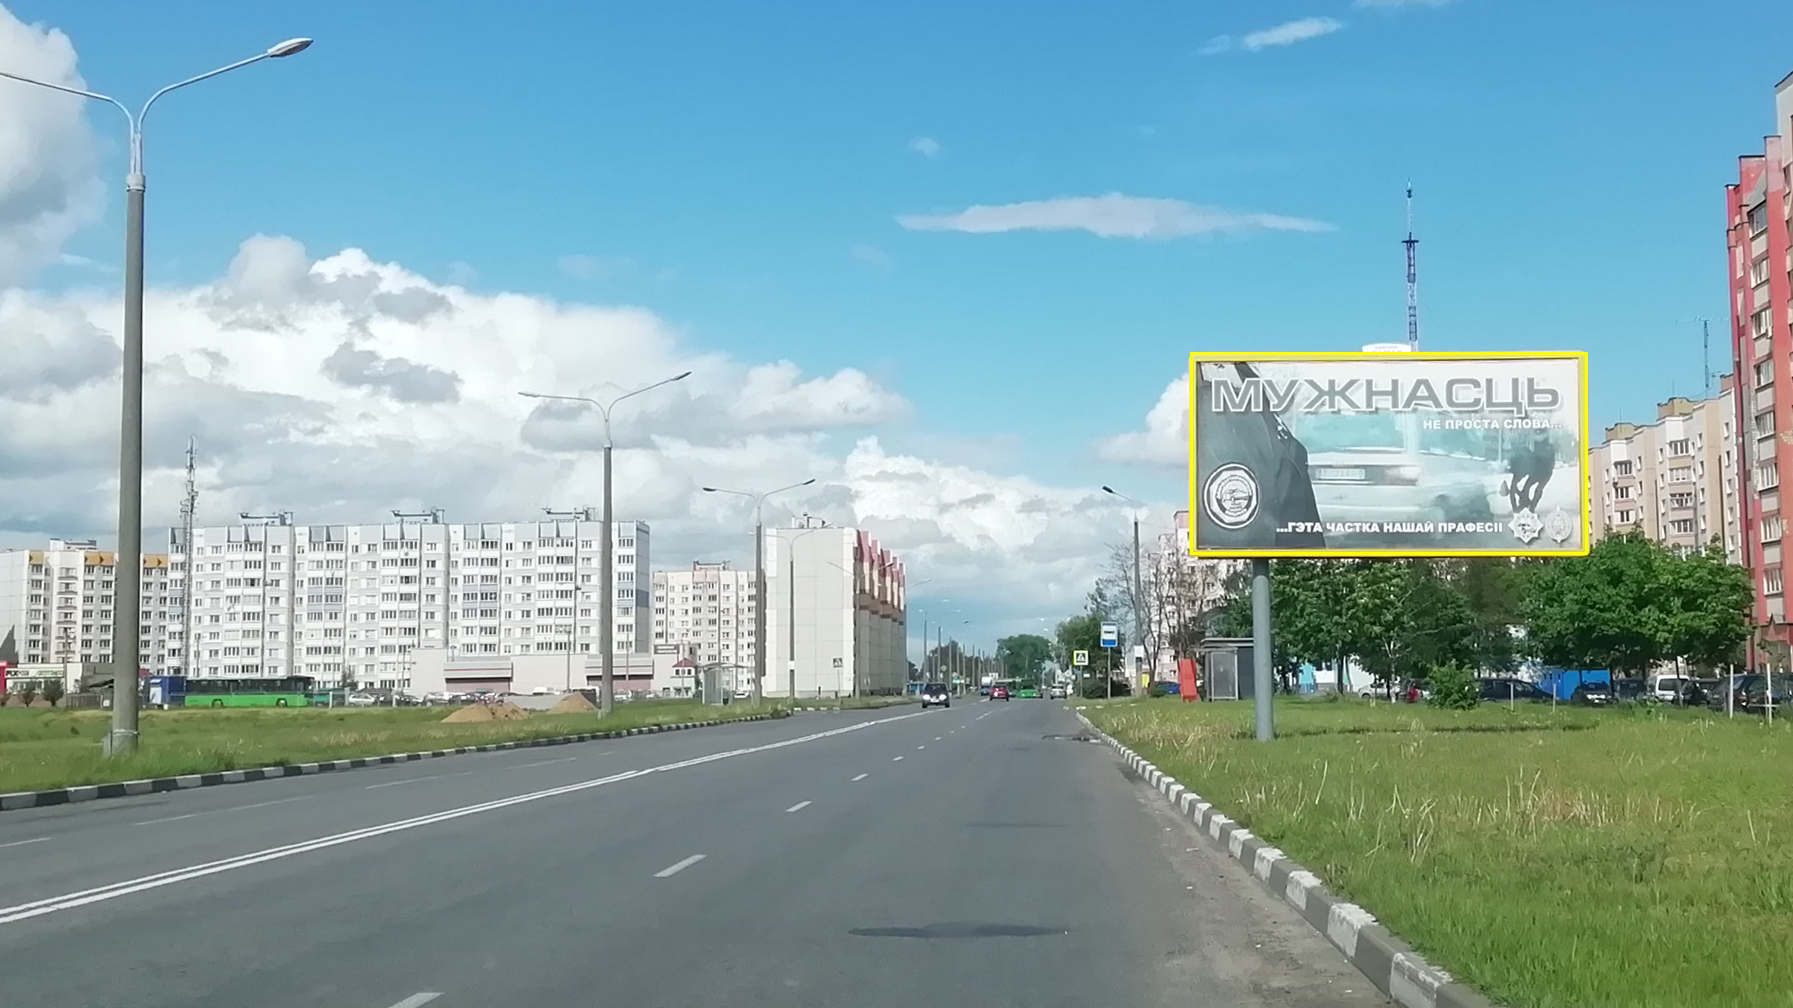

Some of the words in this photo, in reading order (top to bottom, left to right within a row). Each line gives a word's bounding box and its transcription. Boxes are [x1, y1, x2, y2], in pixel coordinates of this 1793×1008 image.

[1210, 377, 1561, 415] МУЖНАСЦЬ
[1423, 420, 1441, 430] НЕ
[1445, 420, 1500, 430] ПРОСТА
[1503, 419, 1563, 430] СЛОВА...
[1276, 522, 1323, 533] ...ГЭТА
[1326, 522, 1380, 533] ЧАСТКА
[1383, 520, 1434, 533] НАШАЙ
[1437, 522, 1503, 533] ПРАФЕСІІ
